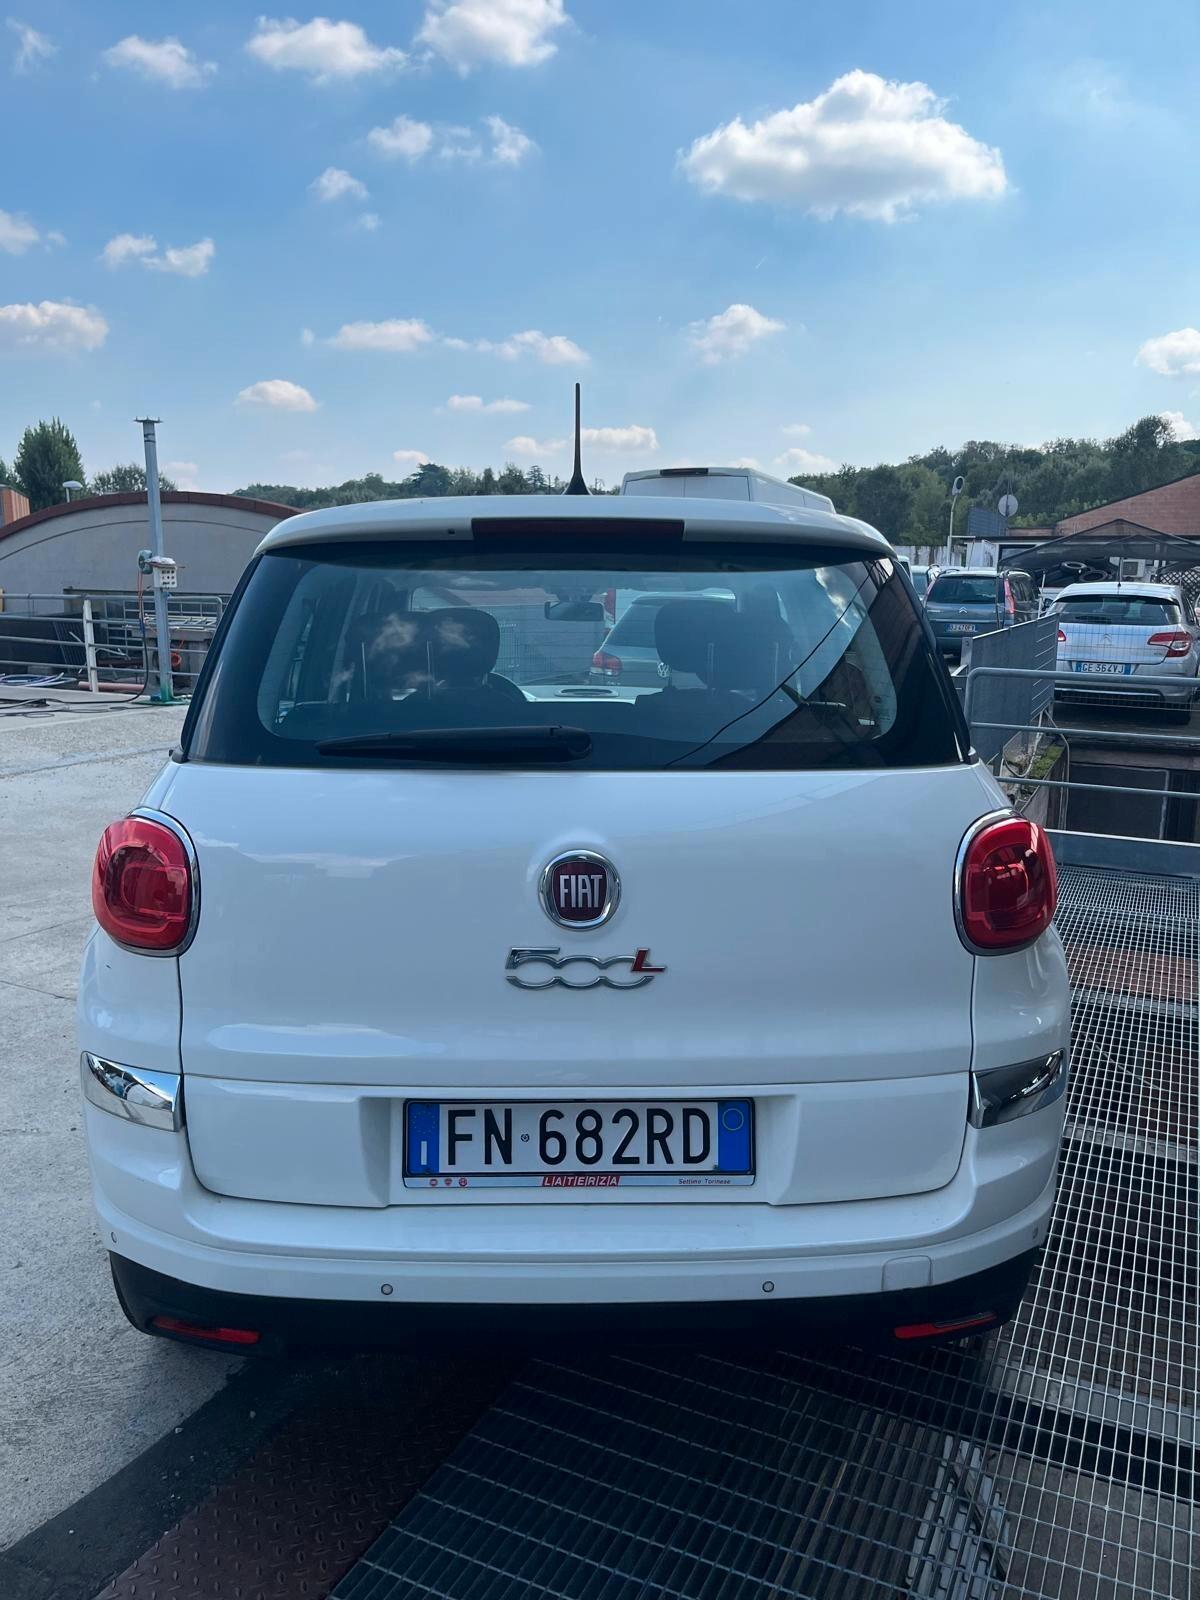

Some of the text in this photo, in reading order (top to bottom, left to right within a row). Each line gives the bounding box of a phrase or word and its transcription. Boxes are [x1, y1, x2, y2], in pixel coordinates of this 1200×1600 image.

[1082, 663, 1094, 672] GE
[559, 874, 603, 908] FIAT
[447, 1108, 513, 1165] FN
[538, 1108, 711, 1165] 682RD
[543, 1175, 619, 1186] LATERZA
